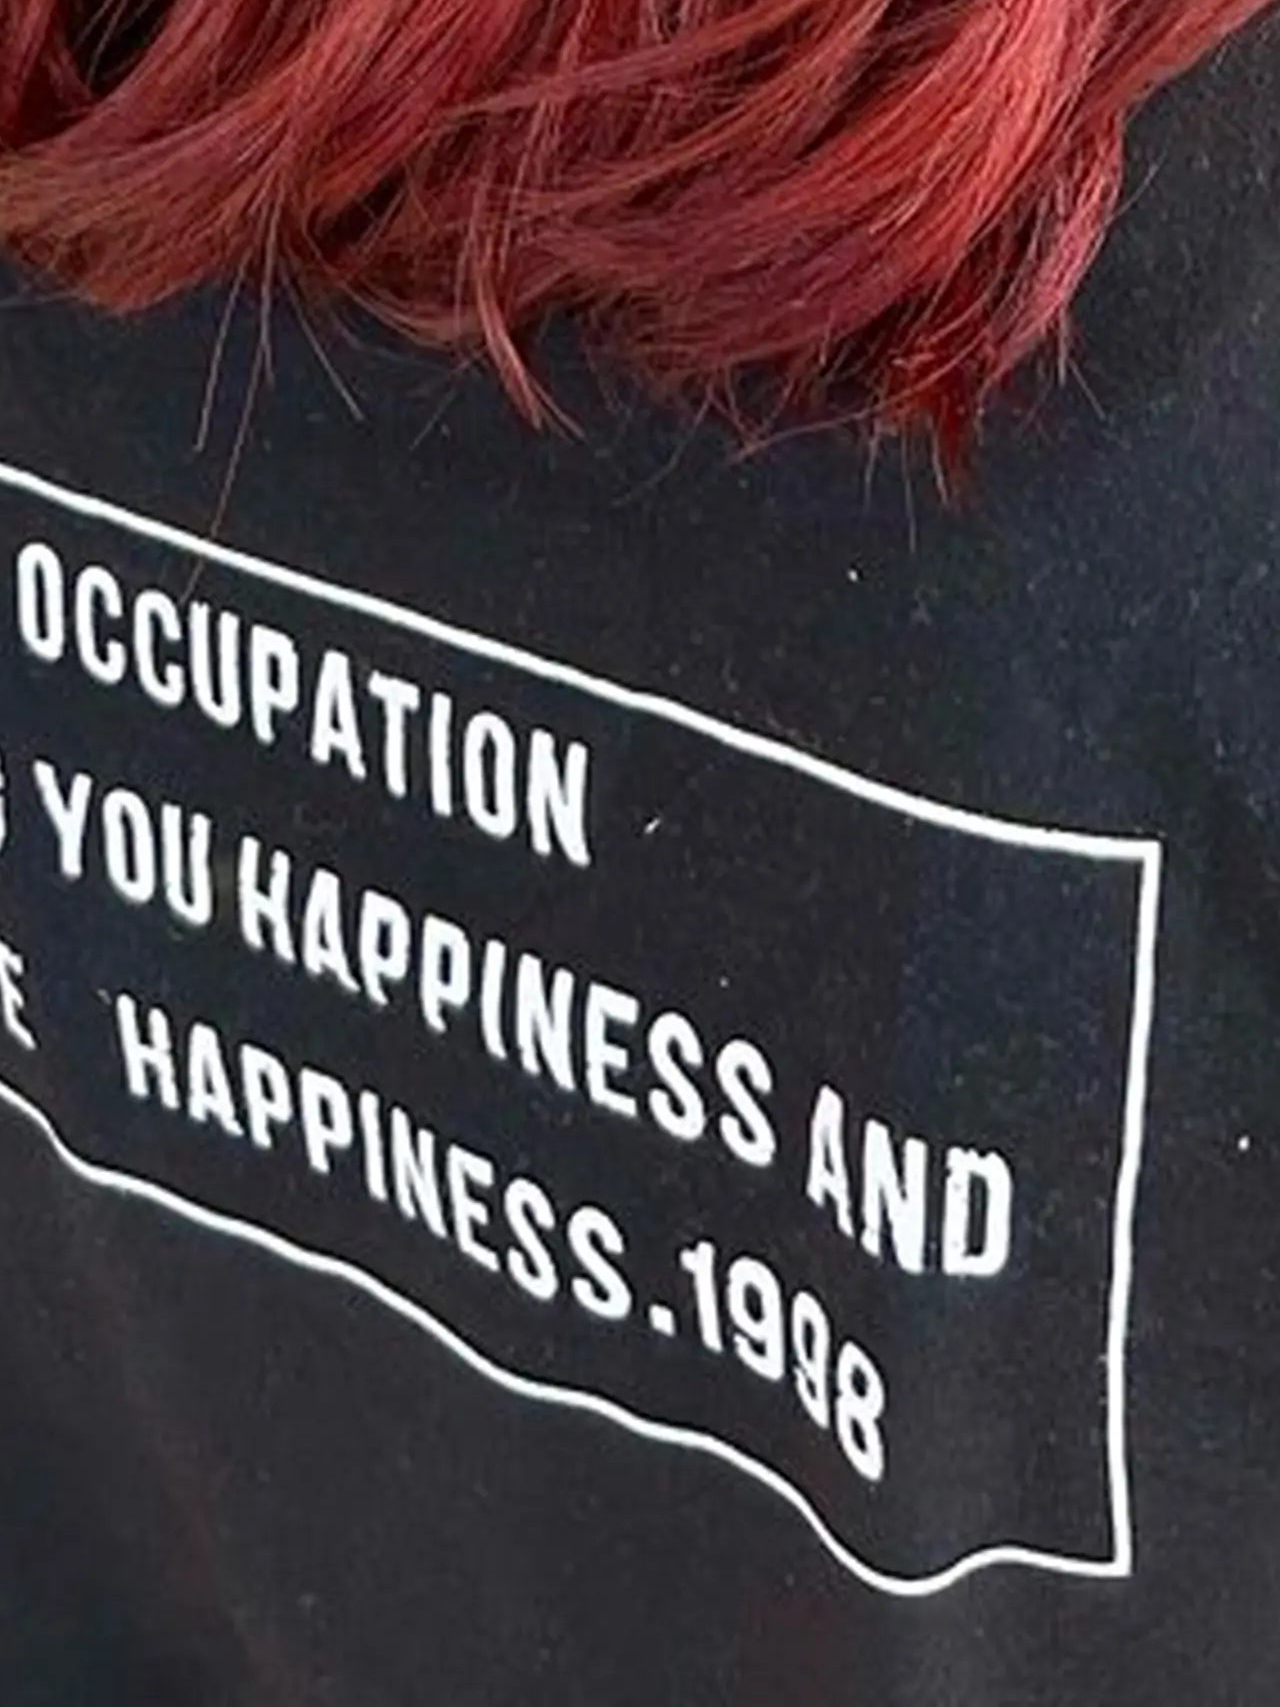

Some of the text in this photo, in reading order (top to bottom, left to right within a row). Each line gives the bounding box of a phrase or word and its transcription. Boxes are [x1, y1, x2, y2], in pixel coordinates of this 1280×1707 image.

[16, 542, 591, 868] OCCUPATION
[32, 759, 213, 927] YOU
[237, 835, 777, 1168] HAPPINESS
[805, 1085, 1013, 1279] AND
